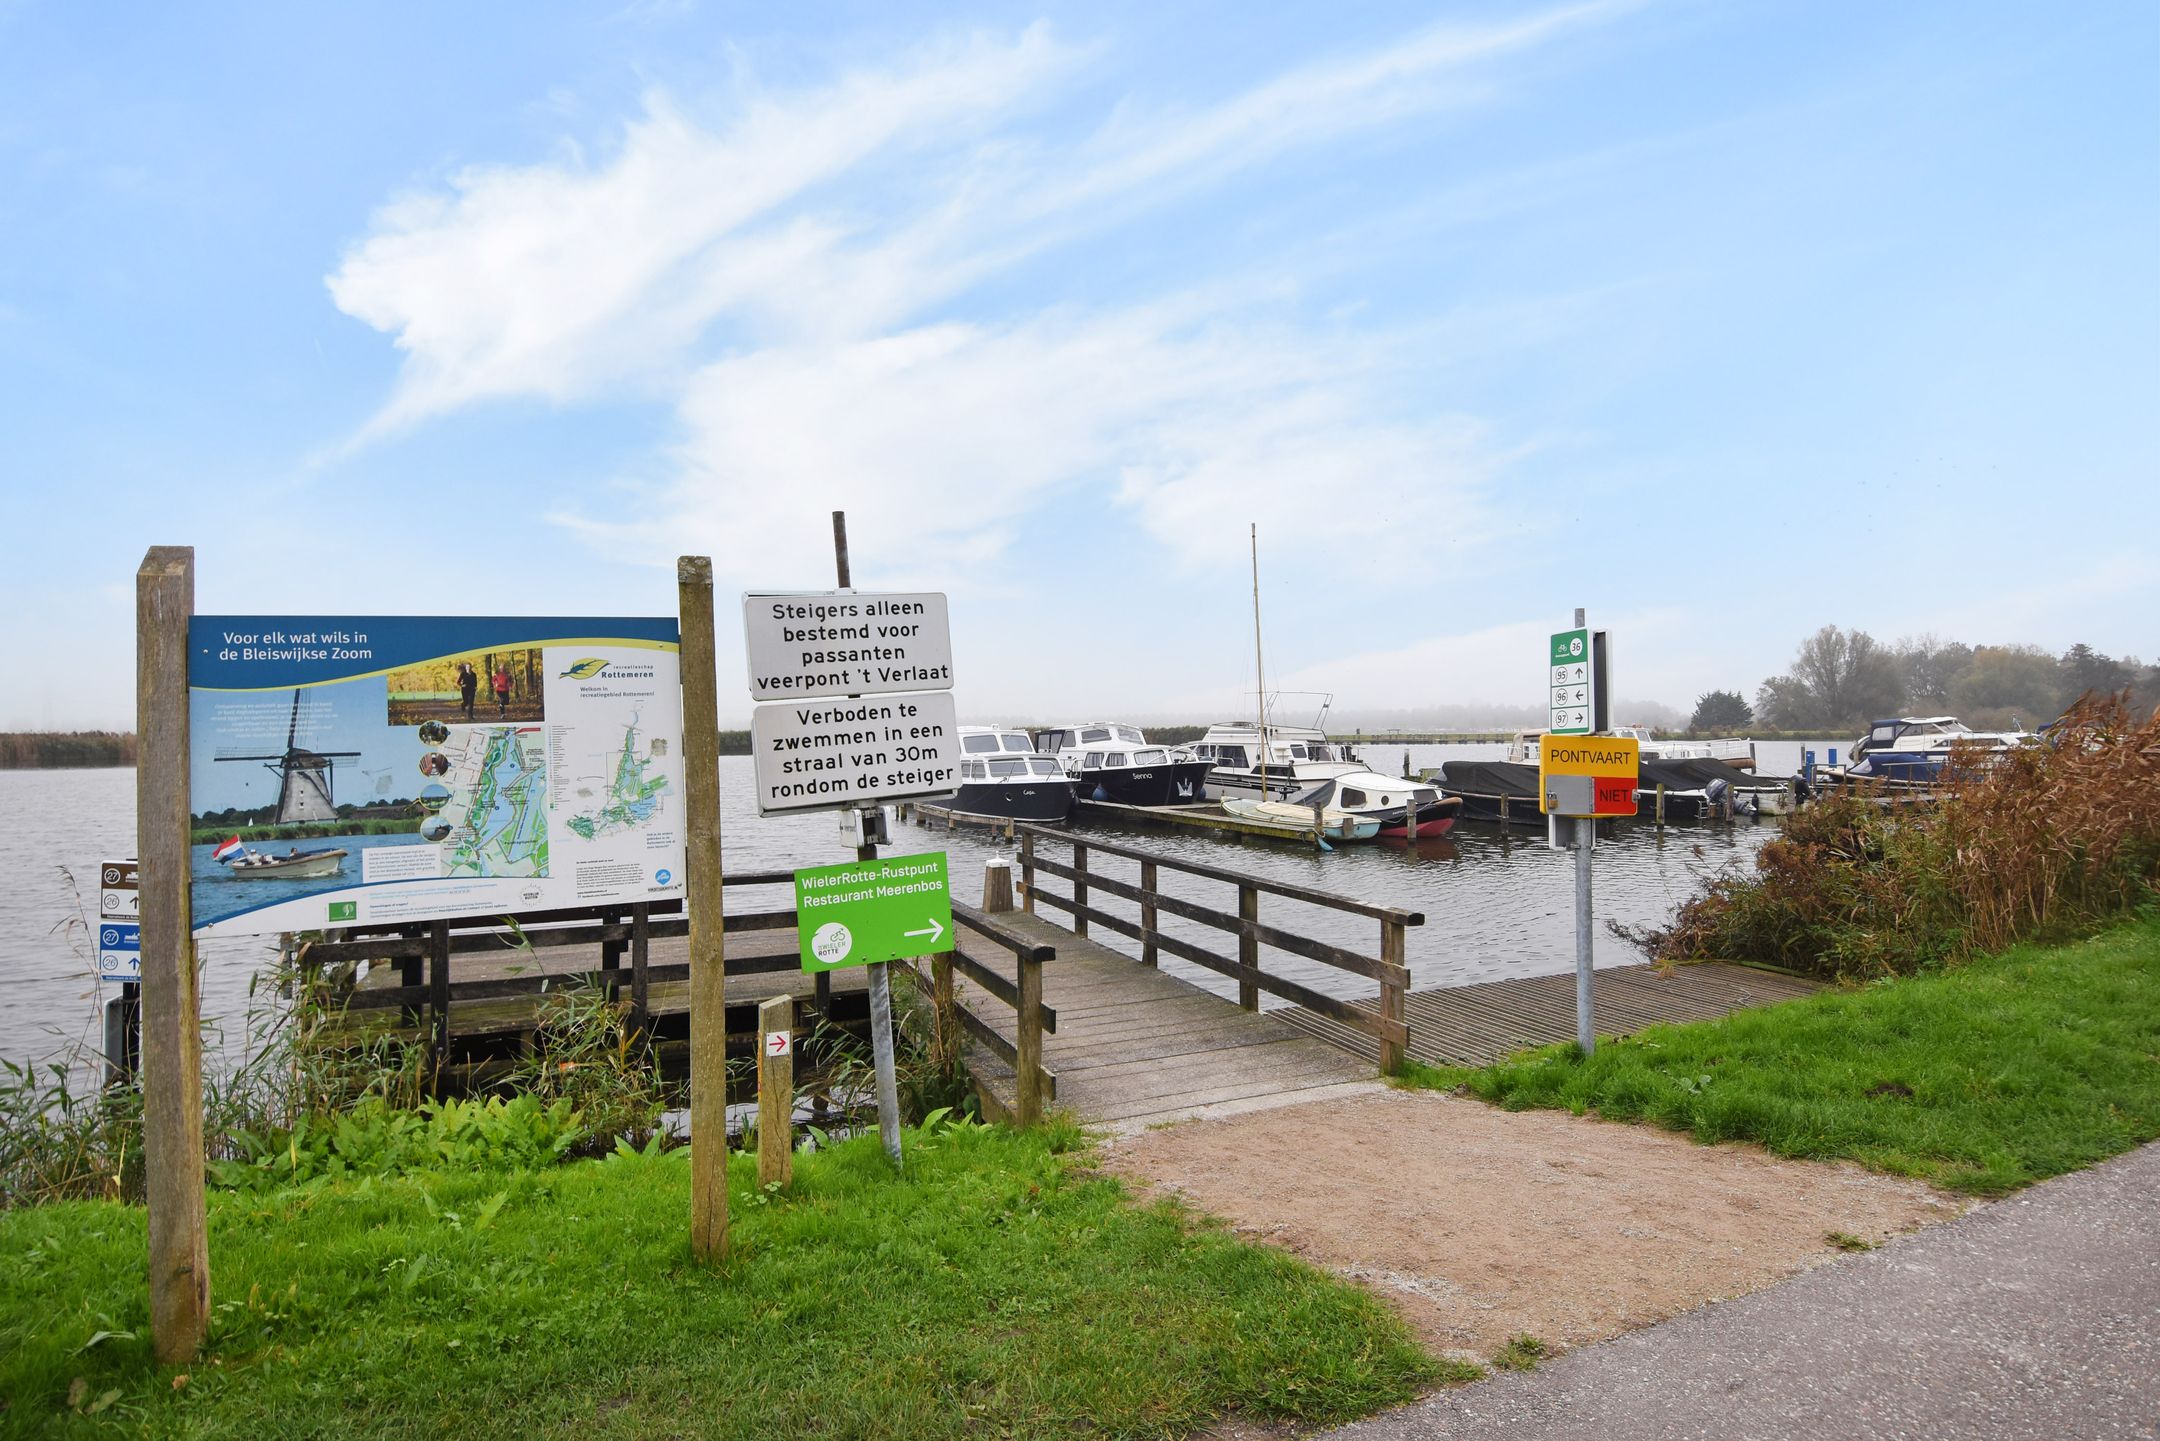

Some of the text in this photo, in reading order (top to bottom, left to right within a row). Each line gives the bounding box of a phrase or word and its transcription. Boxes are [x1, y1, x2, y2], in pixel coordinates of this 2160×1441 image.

[772, 600, 925, 623] Steigers alleen
[223, 631, 368, 645] Voor elk wat wils in
[783, 624, 920, 642] bestemd voor
[1571, 642, 1581, 652] 36
[219, 647, 372, 663] de Bleiswijkse Zoom
[802, 645, 906, 667] passanten
[601, 671, 654, 679] Rottemeren
[757, 664, 949, 690] veerpont 't Verlaat
[1557, 671, 1566, 680] 95
[1557, 692, 1567, 702] 96
[796, 703, 918, 726] Verboden te
[1557, 714, 1567, 724] 97
[773, 724, 943, 751] zwemmen in een
[783, 746, 938, 774] straal van 30m
[1551, 749, 1631, 765] PONTVAART
[771, 766, 954, 799] rondom de steiger
[1132, 772, 1153, 780] Senna
[1600, 789, 1629, 803] NIET
[106, 871, 118, 880] 27
[801, 862, 938, 890] WielerRotte-Rustpunt
[106, 897, 118, 906] 26
[803, 880, 943, 909] Restaurant Meerenbos
[105, 932, 117, 942] 27
[818, 948, 839, 957] ROTTE
[105, 958, 116, 967] 26
